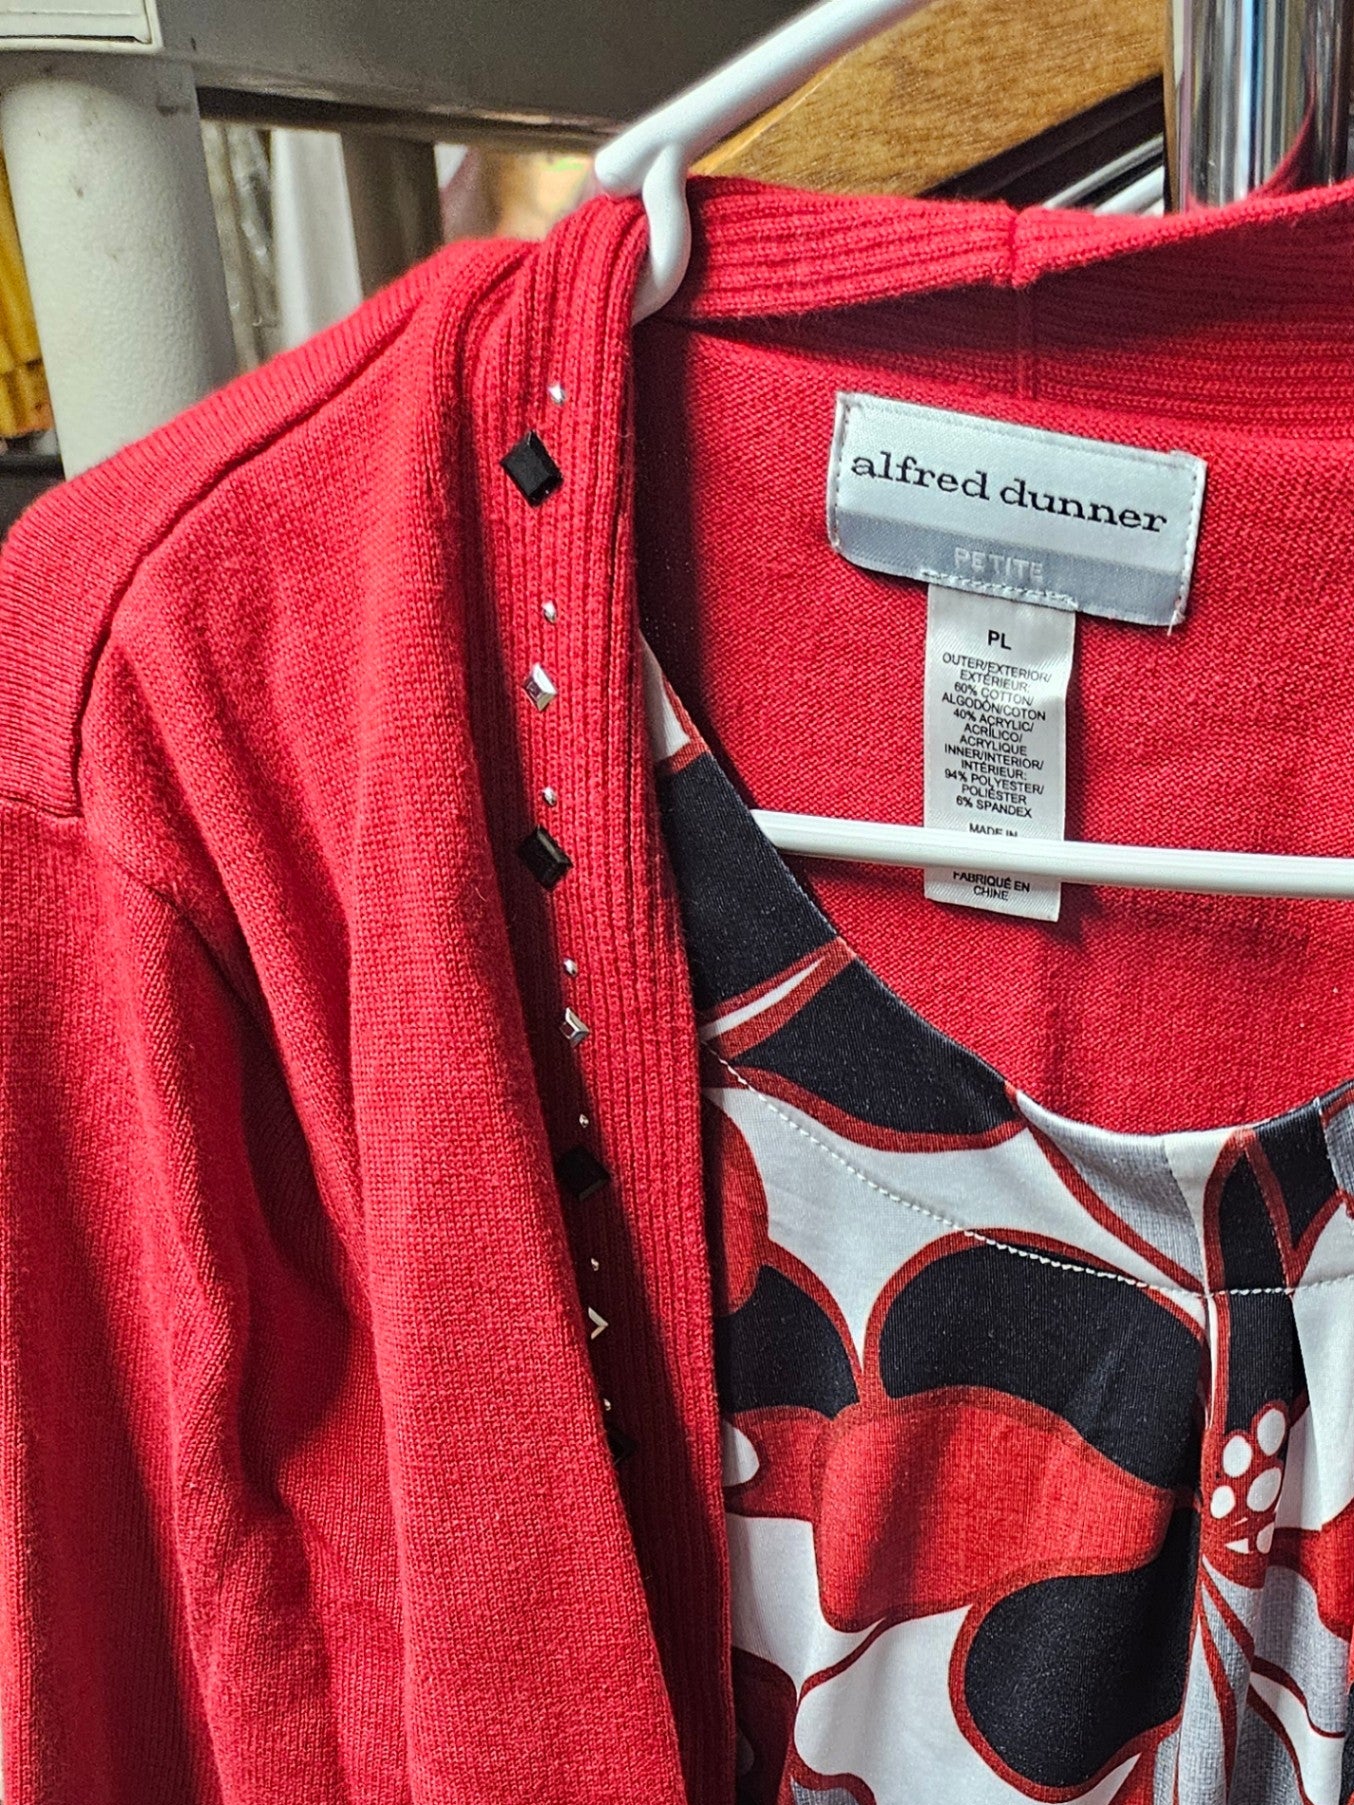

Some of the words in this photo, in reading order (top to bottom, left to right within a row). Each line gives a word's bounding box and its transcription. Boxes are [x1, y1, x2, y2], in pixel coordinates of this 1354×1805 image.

[851, 452, 990, 501] alfred
[1000, 479, 1168, 532] dunner
[954, 547, 1043, 582] PETITE
[987, 630, 1012, 650] PL
[942, 652, 1052, 682] OUTER/EXTERIOR/
[954, 681, 977, 696] 60%
[981, 687, 1034, 706] COTTON/
[953, 708, 976, 722] 40%
[979, 713, 1034, 732] ACRYLIC/
[945, 743, 1044, 771] INNER/INTERIOR/
[960, 734, 1027, 756] ACRYLIQUE
[945, 768, 968, 782] 94%
[971, 773, 1045, 795] POLYESTER/
[961, 759, 1027, 781] INTÉRIEUR:
[956, 795, 973, 808] 6%
[976, 799, 1033, 819] SPANDEX
[969, 822, 1003, 836] MADE
[1006, 829, 1018, 837] IN
[953, 871, 1012, 890] FABRIQUÉ
[1013, 880, 1031, 893] EN
[973, 885, 1009, 901] CHINE
